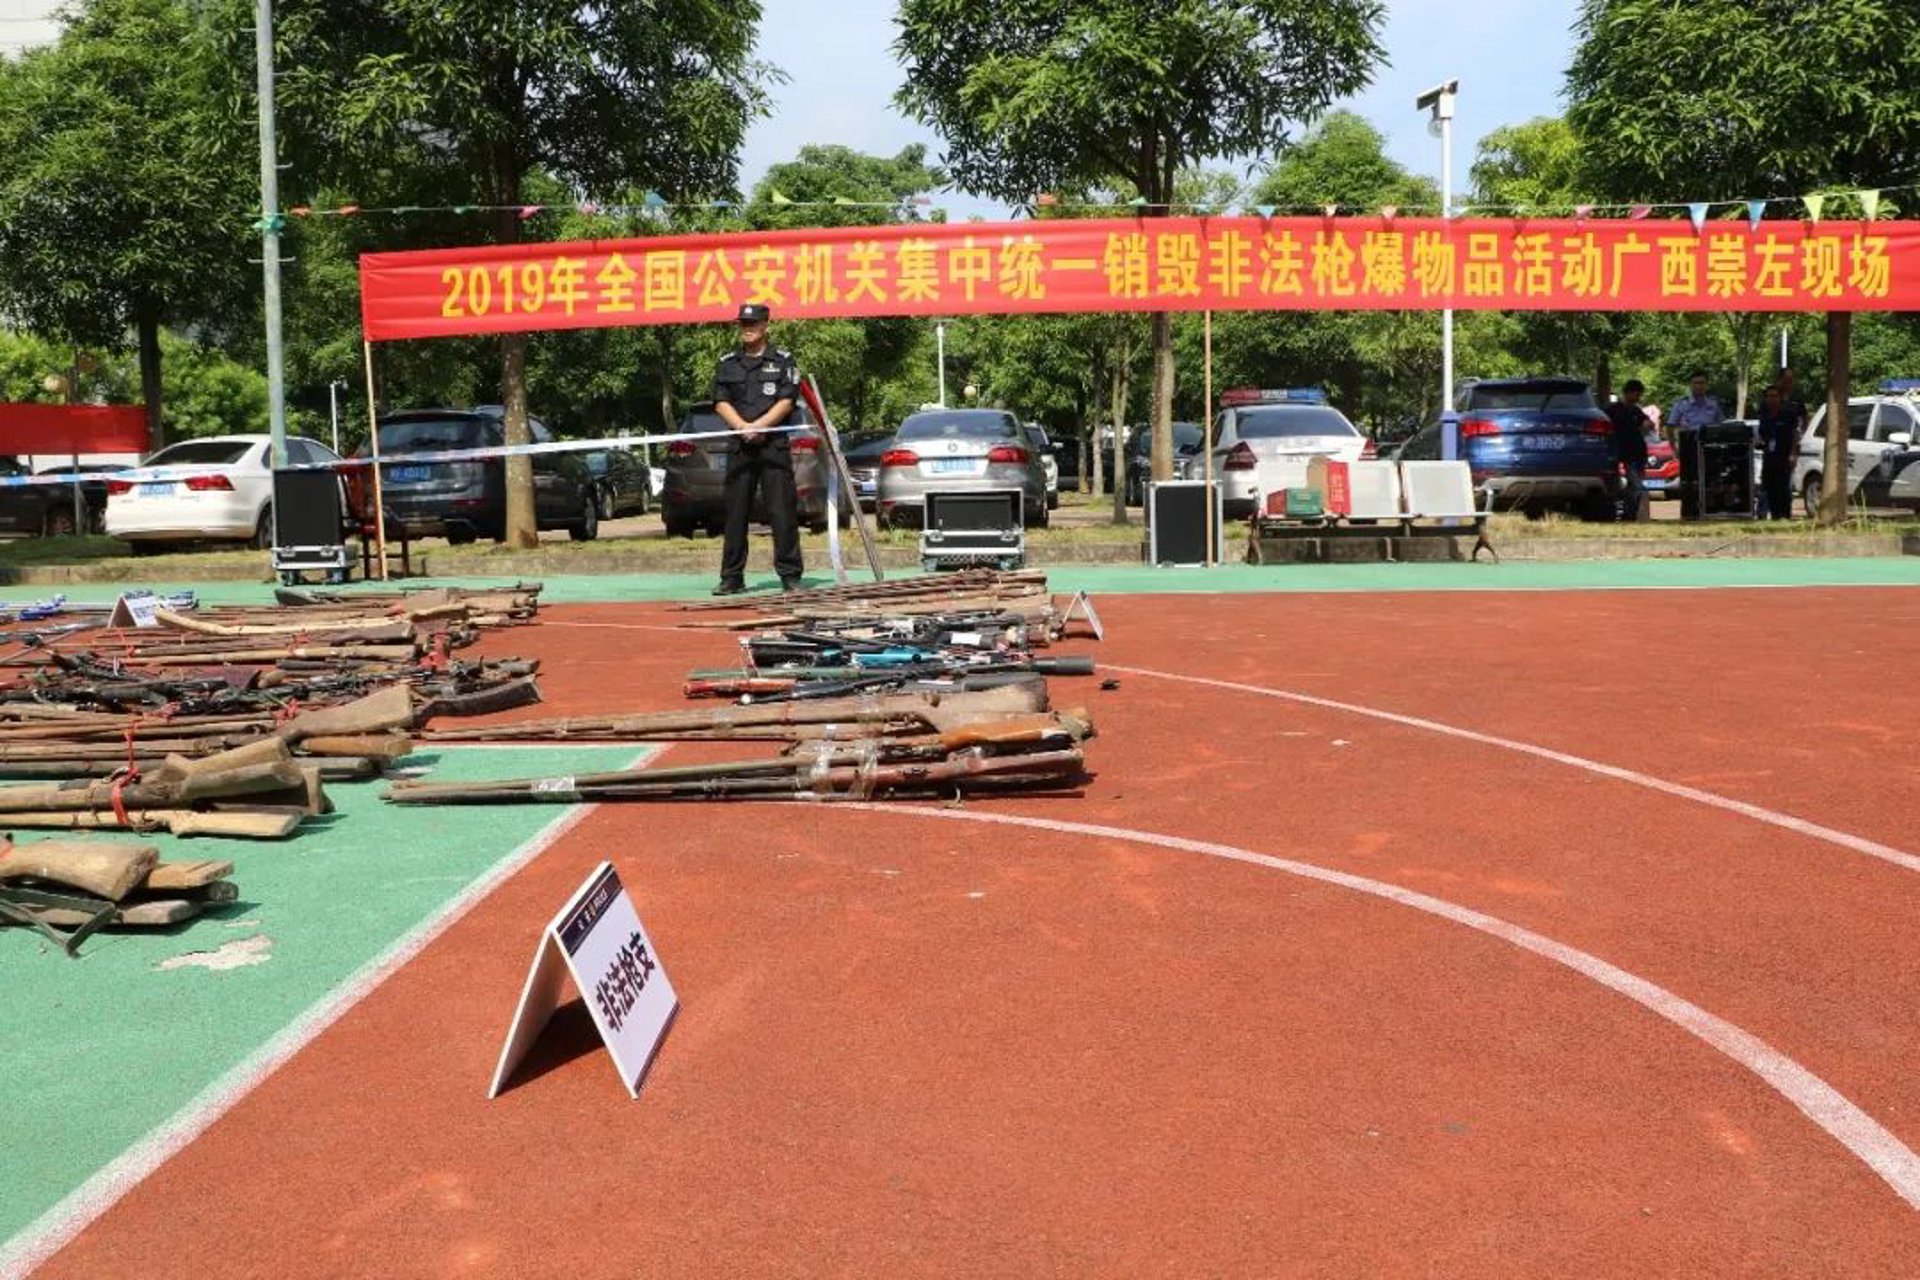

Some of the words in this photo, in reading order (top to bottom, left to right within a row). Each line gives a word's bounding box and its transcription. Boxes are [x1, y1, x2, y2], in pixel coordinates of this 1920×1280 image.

[441, 231, 1891, 317] 2019年全国公安机关集中统一销毁非法枪爆物品活动广西崇左现场
[596, 931, 655, 1033] 非法枪支
